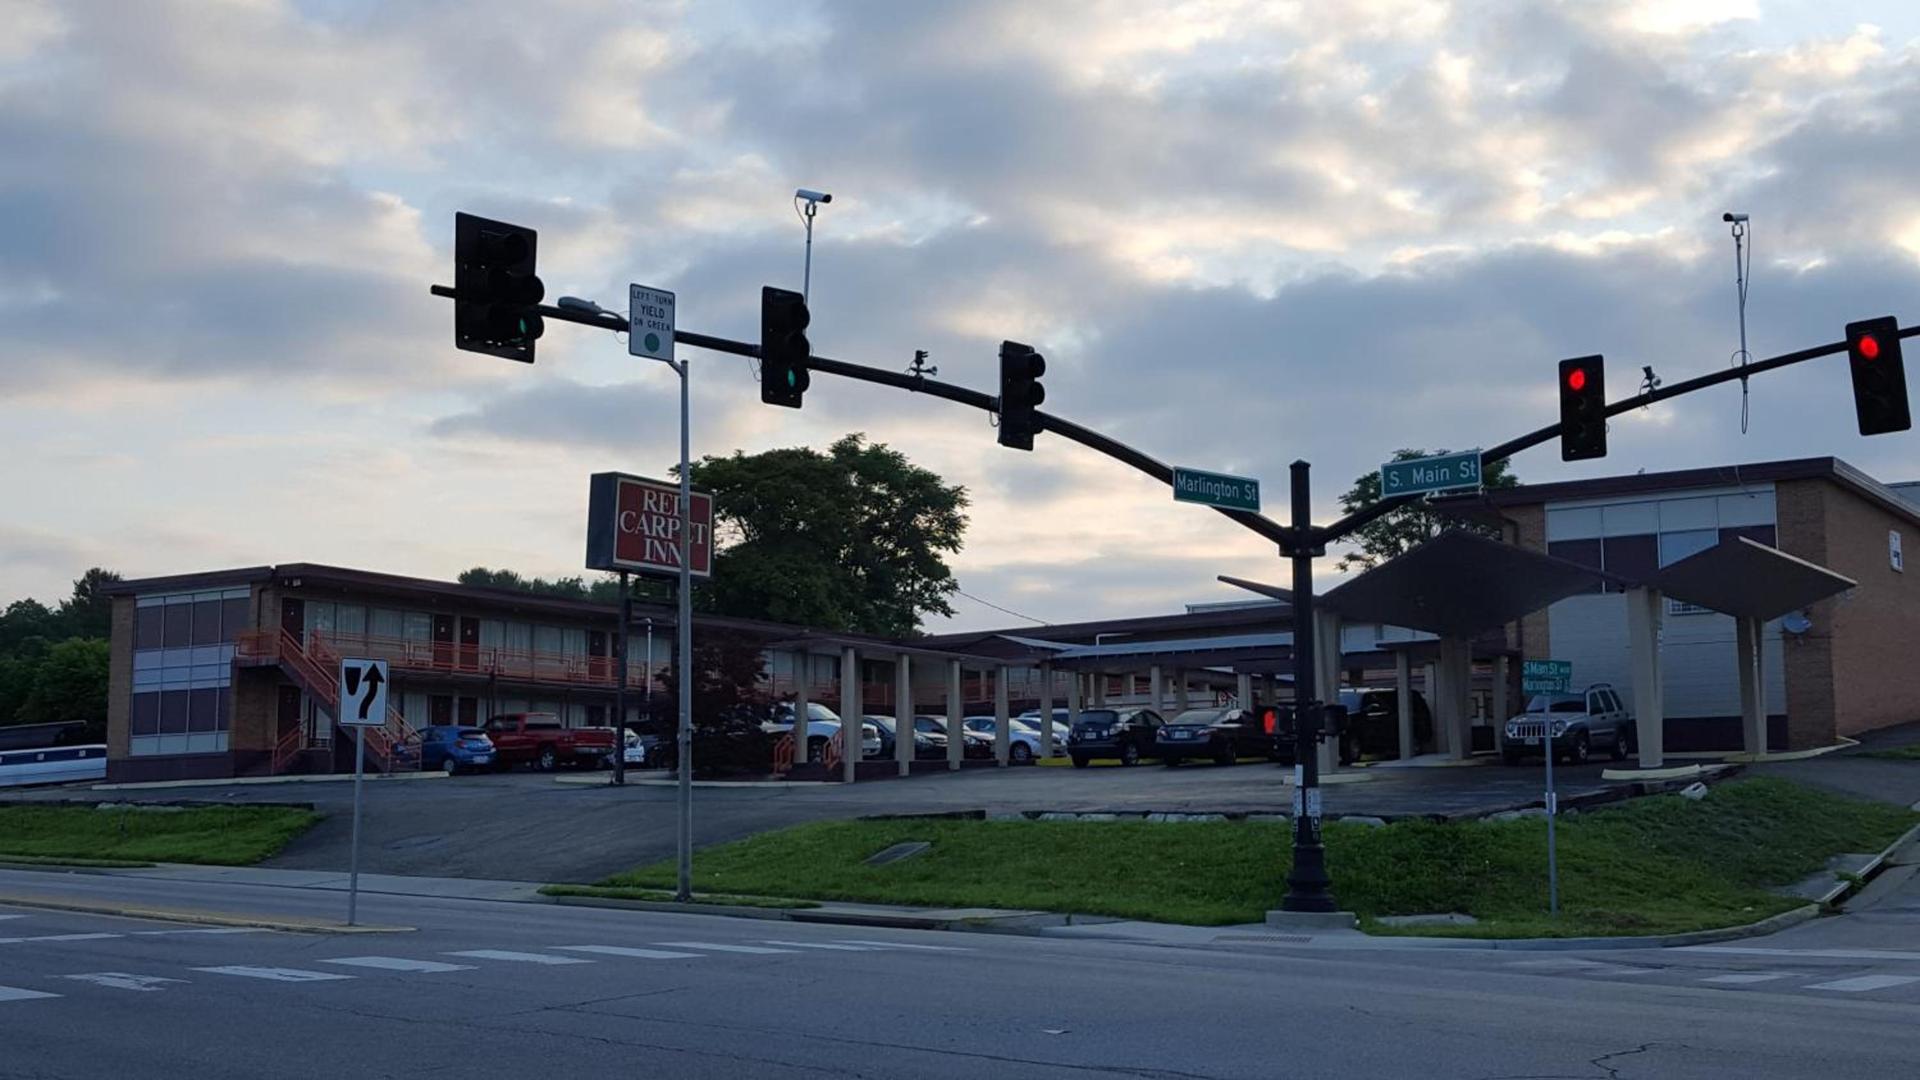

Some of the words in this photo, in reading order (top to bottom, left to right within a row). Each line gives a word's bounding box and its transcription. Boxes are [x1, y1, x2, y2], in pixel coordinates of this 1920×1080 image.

[633, 289, 650, 300] LEFT
[655, 296, 673, 306] TURN
[641, 303, 665, 319] YIELD
[634, 316, 643, 326] ON
[647, 319, 670, 332] GREEN
[1390, 471, 1404, 488] S.
[1412, 465, 1450, 485] Main
[1459, 461, 1477, 479] St
[1177, 473, 1239, 501] Marlington
[1244, 484, 1257, 502] St
[643, 537, 683, 565] INN
